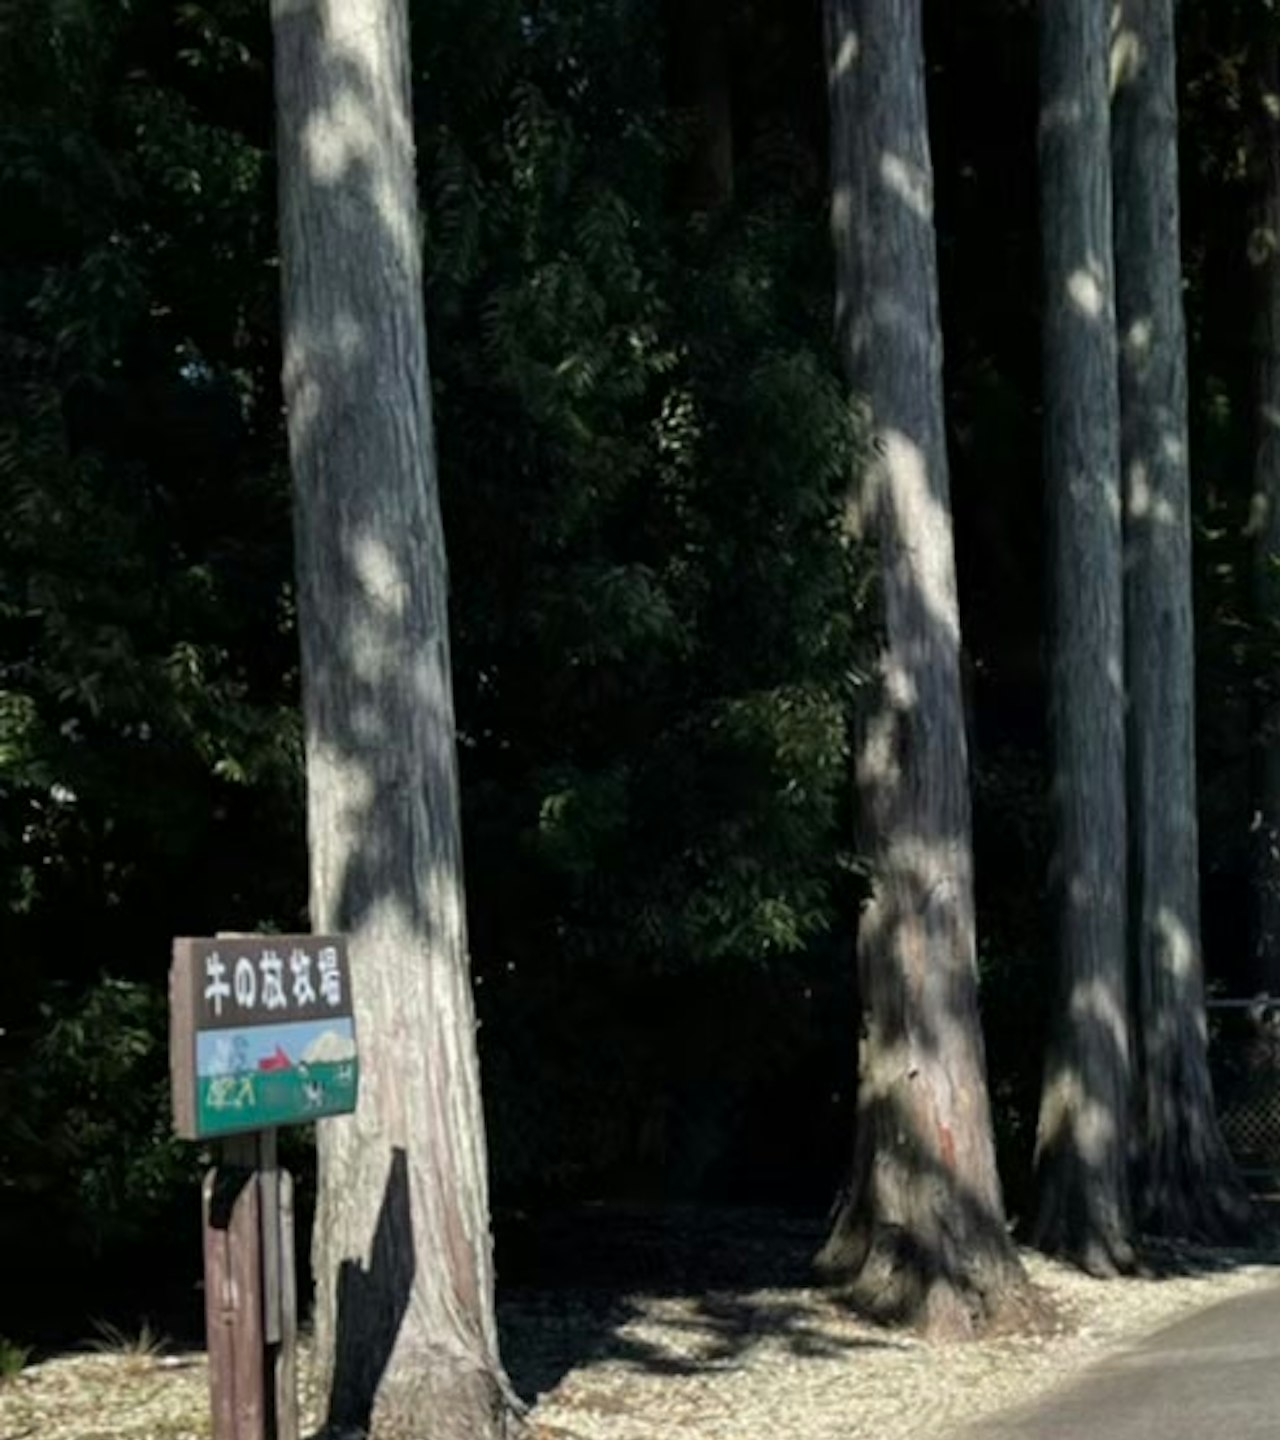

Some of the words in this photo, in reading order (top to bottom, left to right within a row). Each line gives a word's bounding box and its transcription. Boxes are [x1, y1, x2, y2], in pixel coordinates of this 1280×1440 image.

[204, 946, 341, 1016] 牛の放牧場
